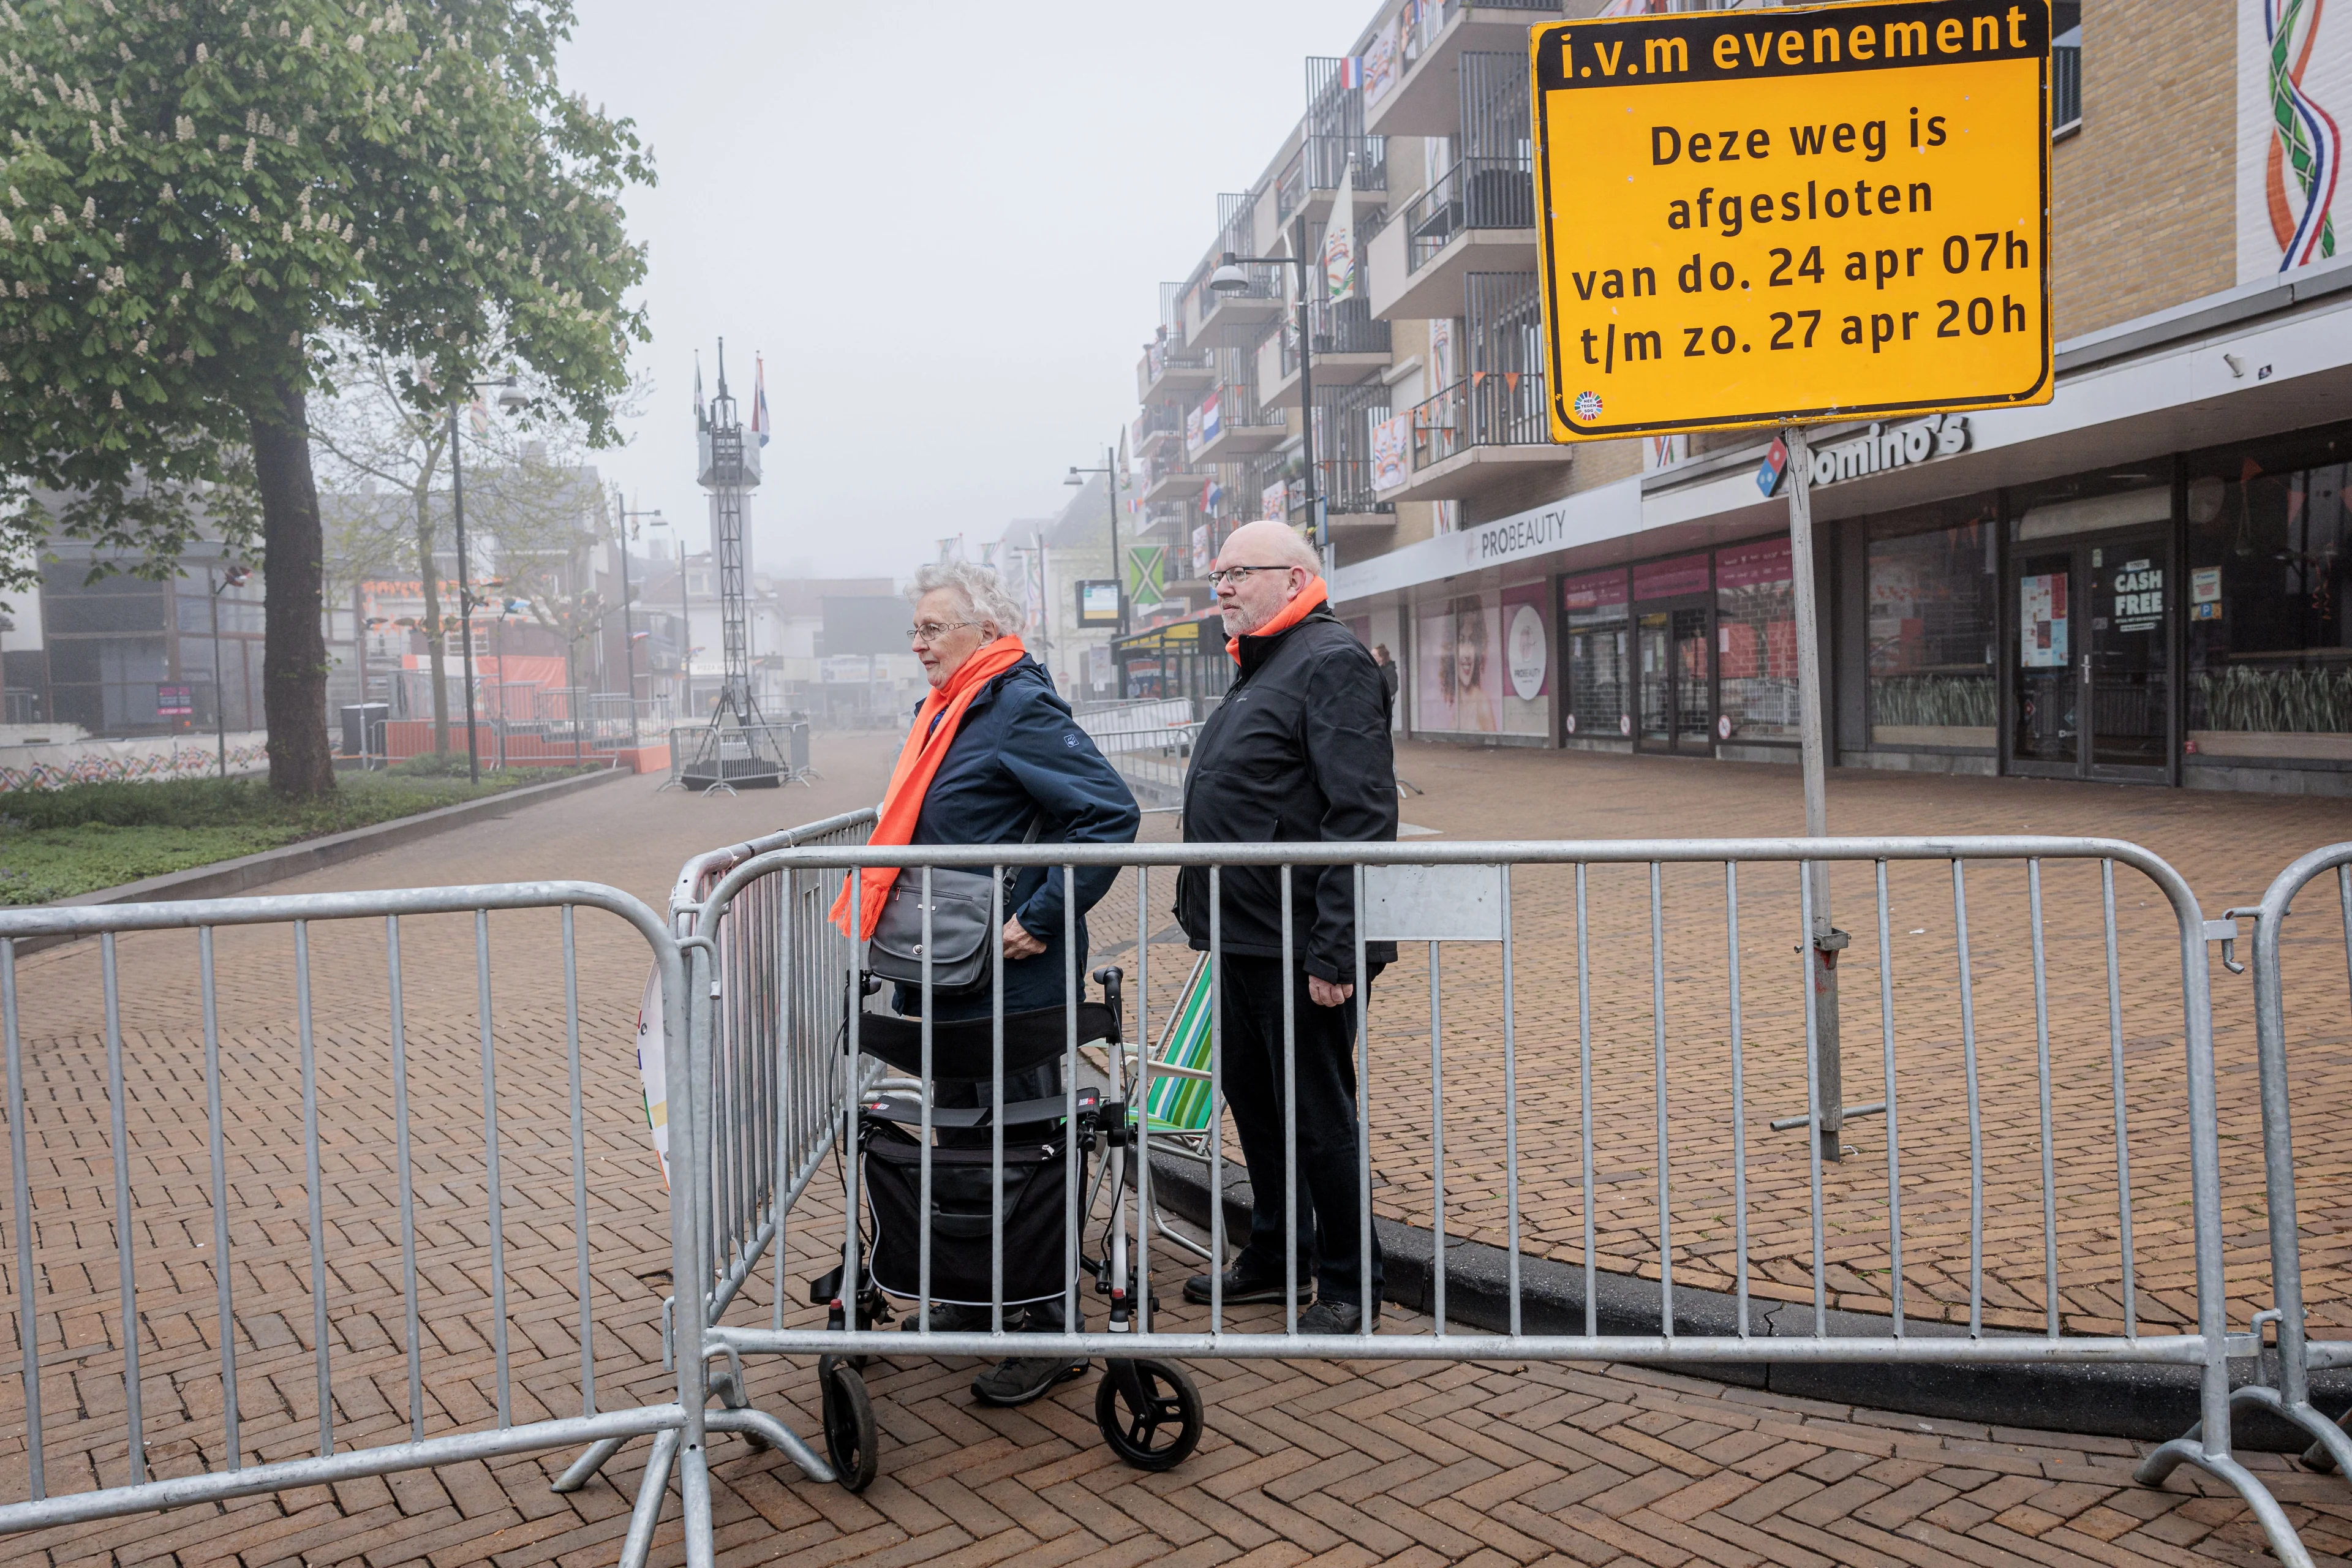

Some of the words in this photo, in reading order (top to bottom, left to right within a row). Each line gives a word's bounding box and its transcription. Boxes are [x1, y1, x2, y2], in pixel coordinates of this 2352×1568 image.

[1562, 34, 1688, 78] i.v.m
[1713, 6, 2027, 69] evenement
[1651, 126, 1770, 166] Deze
[1789, 120, 1886, 162] weg
[1910, 107, 1947, 148] is
[1668, 179, 1931, 237] afgesloten
[1572, 267, 1656, 301] van
[1678, 253, 1749, 293] do.
[1769, 246, 1825, 287] 24
[1845, 247, 1924, 290] apr
[1943, 230, 2028, 274] 07h
[1580, 323, 1662, 374] t/m
[1684, 325, 1751, 357] zo.
[1770, 309, 1821, 350] 27
[1841, 311, 1919, 353] apr
[1937, 294, 2026, 338] 20h
[1482, 509, 1566, 559] PROBEAUTY
[2114, 569, 2163, 593] CASH
[2114, 591, 2163, 617] FREE
